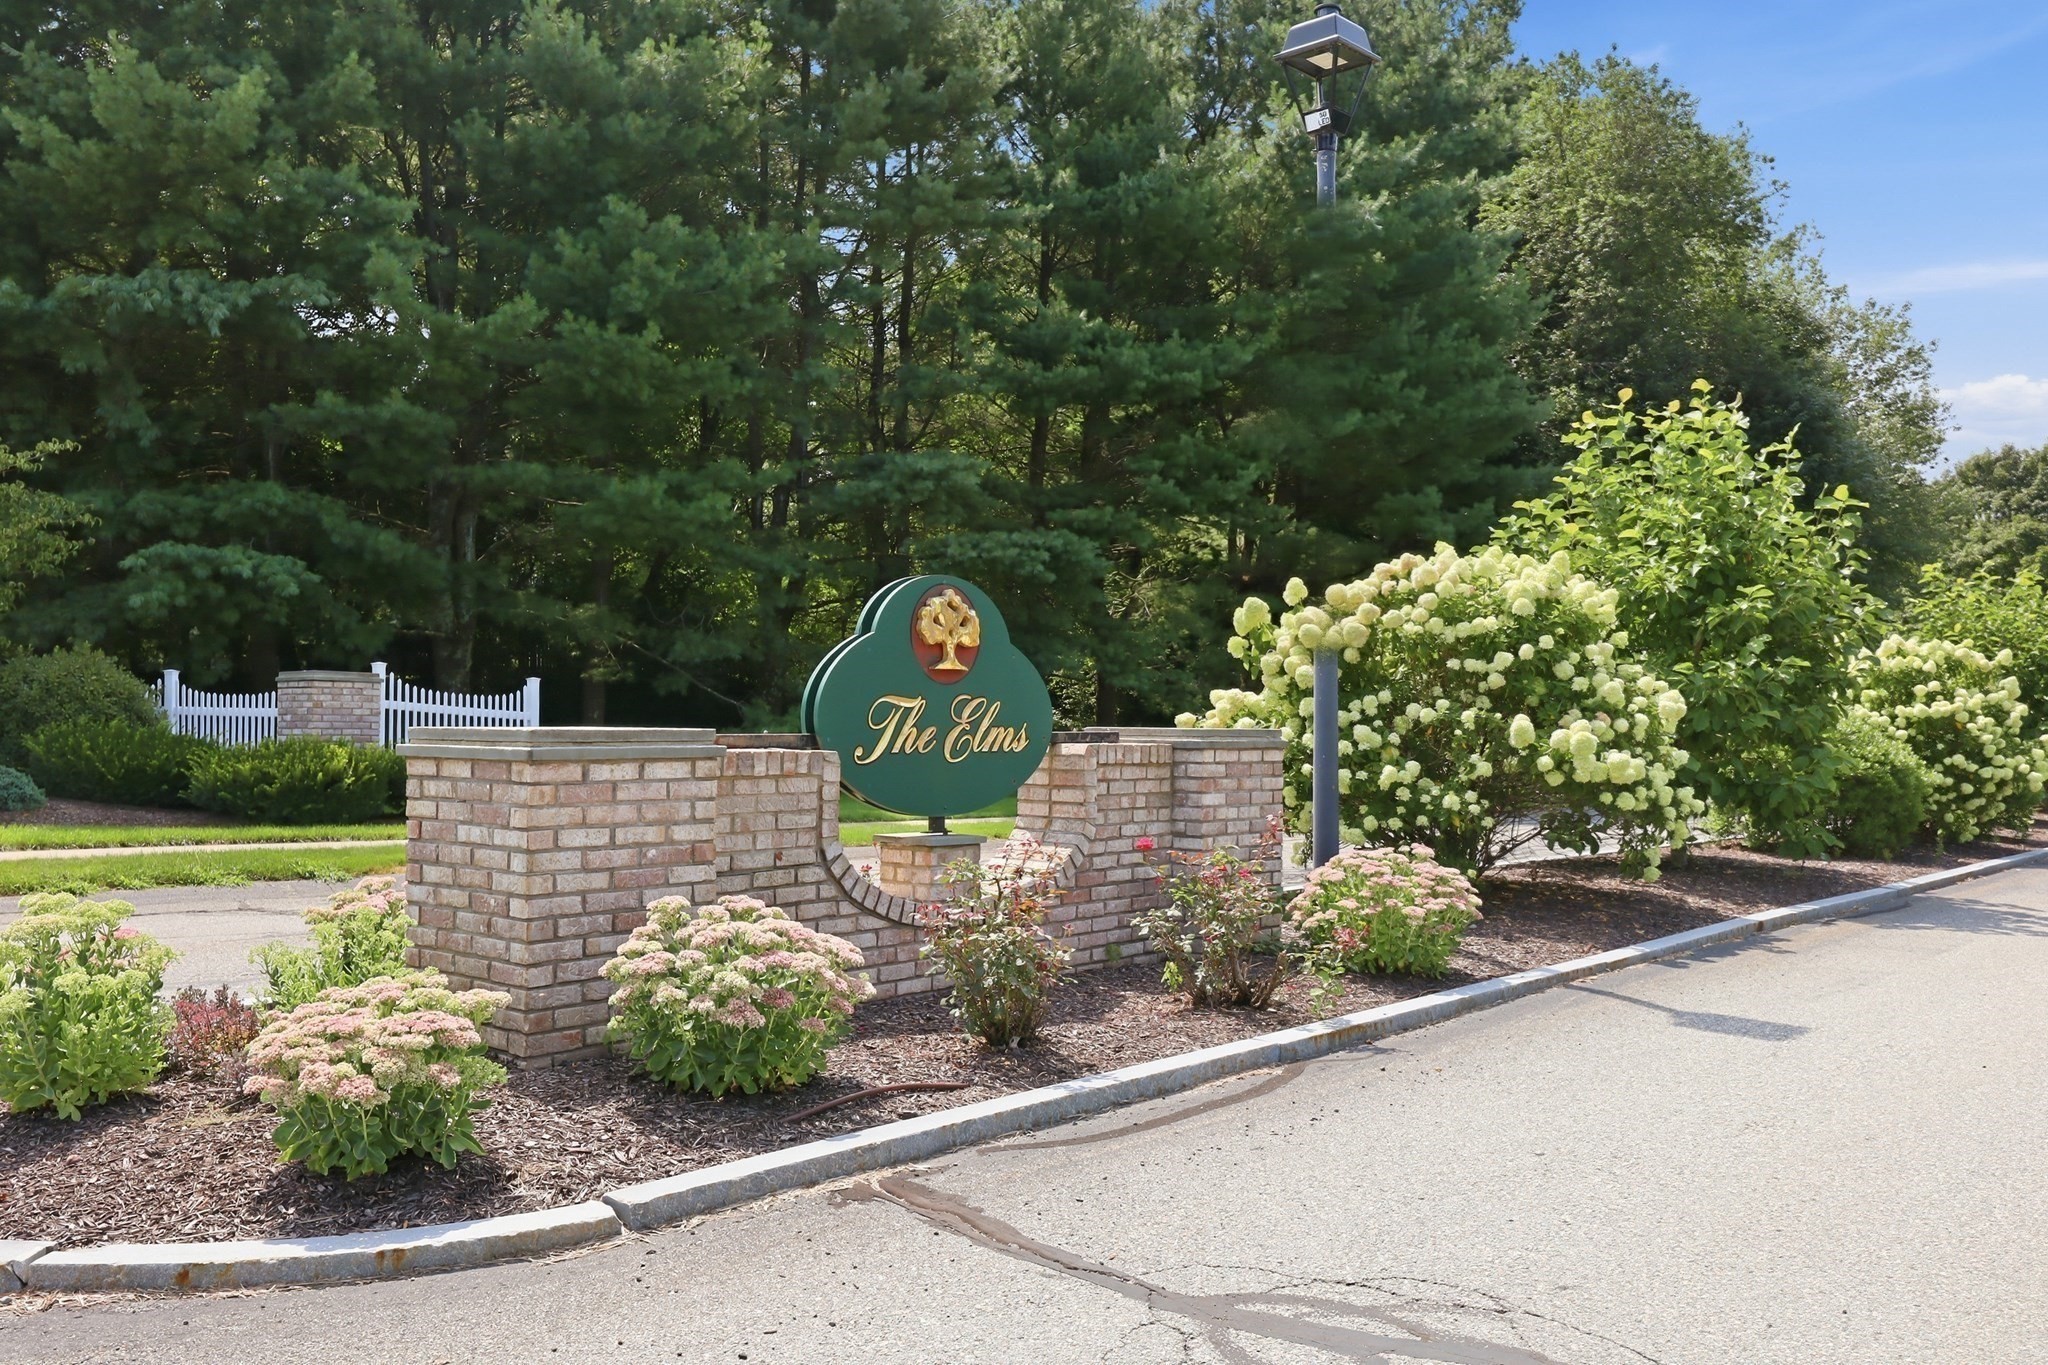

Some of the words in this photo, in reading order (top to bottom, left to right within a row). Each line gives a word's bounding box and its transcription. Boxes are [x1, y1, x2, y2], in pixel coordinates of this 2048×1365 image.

[1318, 117, 1330, 126] LED
[853, 694, 937, 765] The
[943, 694, 1030, 763] Elms
